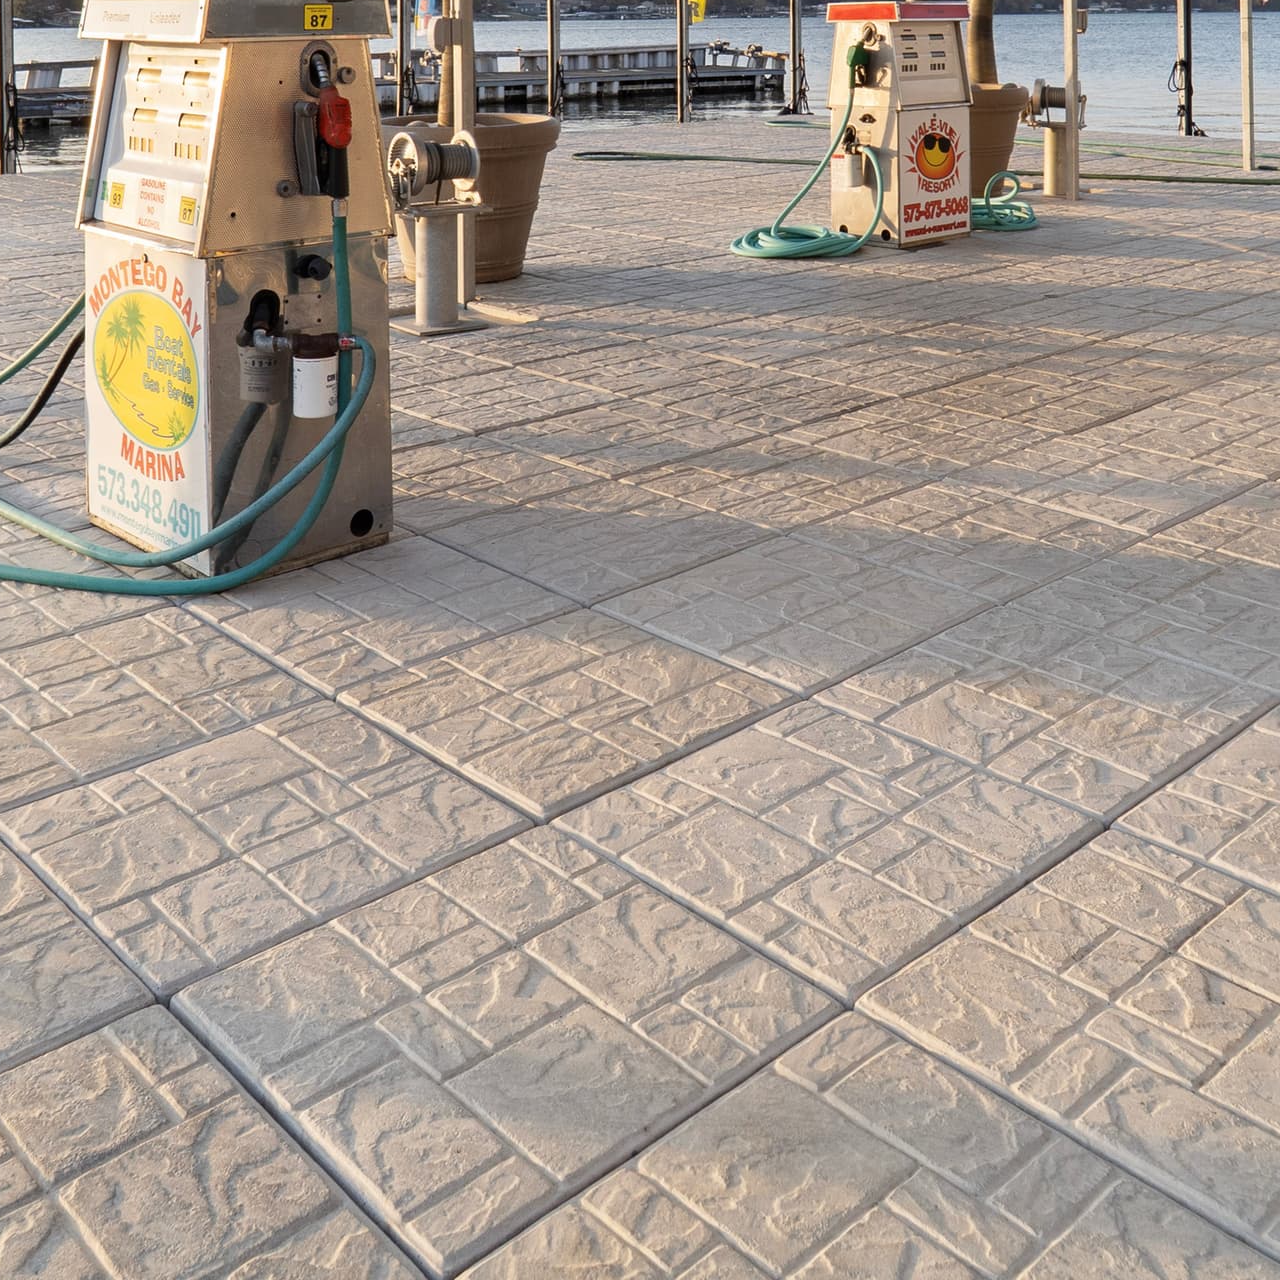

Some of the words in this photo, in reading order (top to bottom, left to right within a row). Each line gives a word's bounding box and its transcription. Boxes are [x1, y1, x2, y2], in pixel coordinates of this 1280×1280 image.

[311, 14, 328, 27] 87
[911, 118, 957, 145] VAL-E-VUE
[141, 177, 167, 191] GASOLINE
[921, 174, 956, 193] RESORT
[112, 193, 122, 206] 93
[139, 191, 165, 204] CONTAINS
[146, 205, 155, 215] NO
[903, 195, 969, 224] 573-873-5068
[182, 208, 192, 221] 87
[88, 258, 167, 318] MONTEGO
[172, 277, 202, 338] BAY
[154, 325, 184, 359] Boat
[146, 346, 192, 385] Rentals
[141, 372, 161, 394] Gas
[166, 380, 195, 410] Service
[120, 432, 186, 482] MARINA
[97, 463, 201, 544] 573.348.4911
